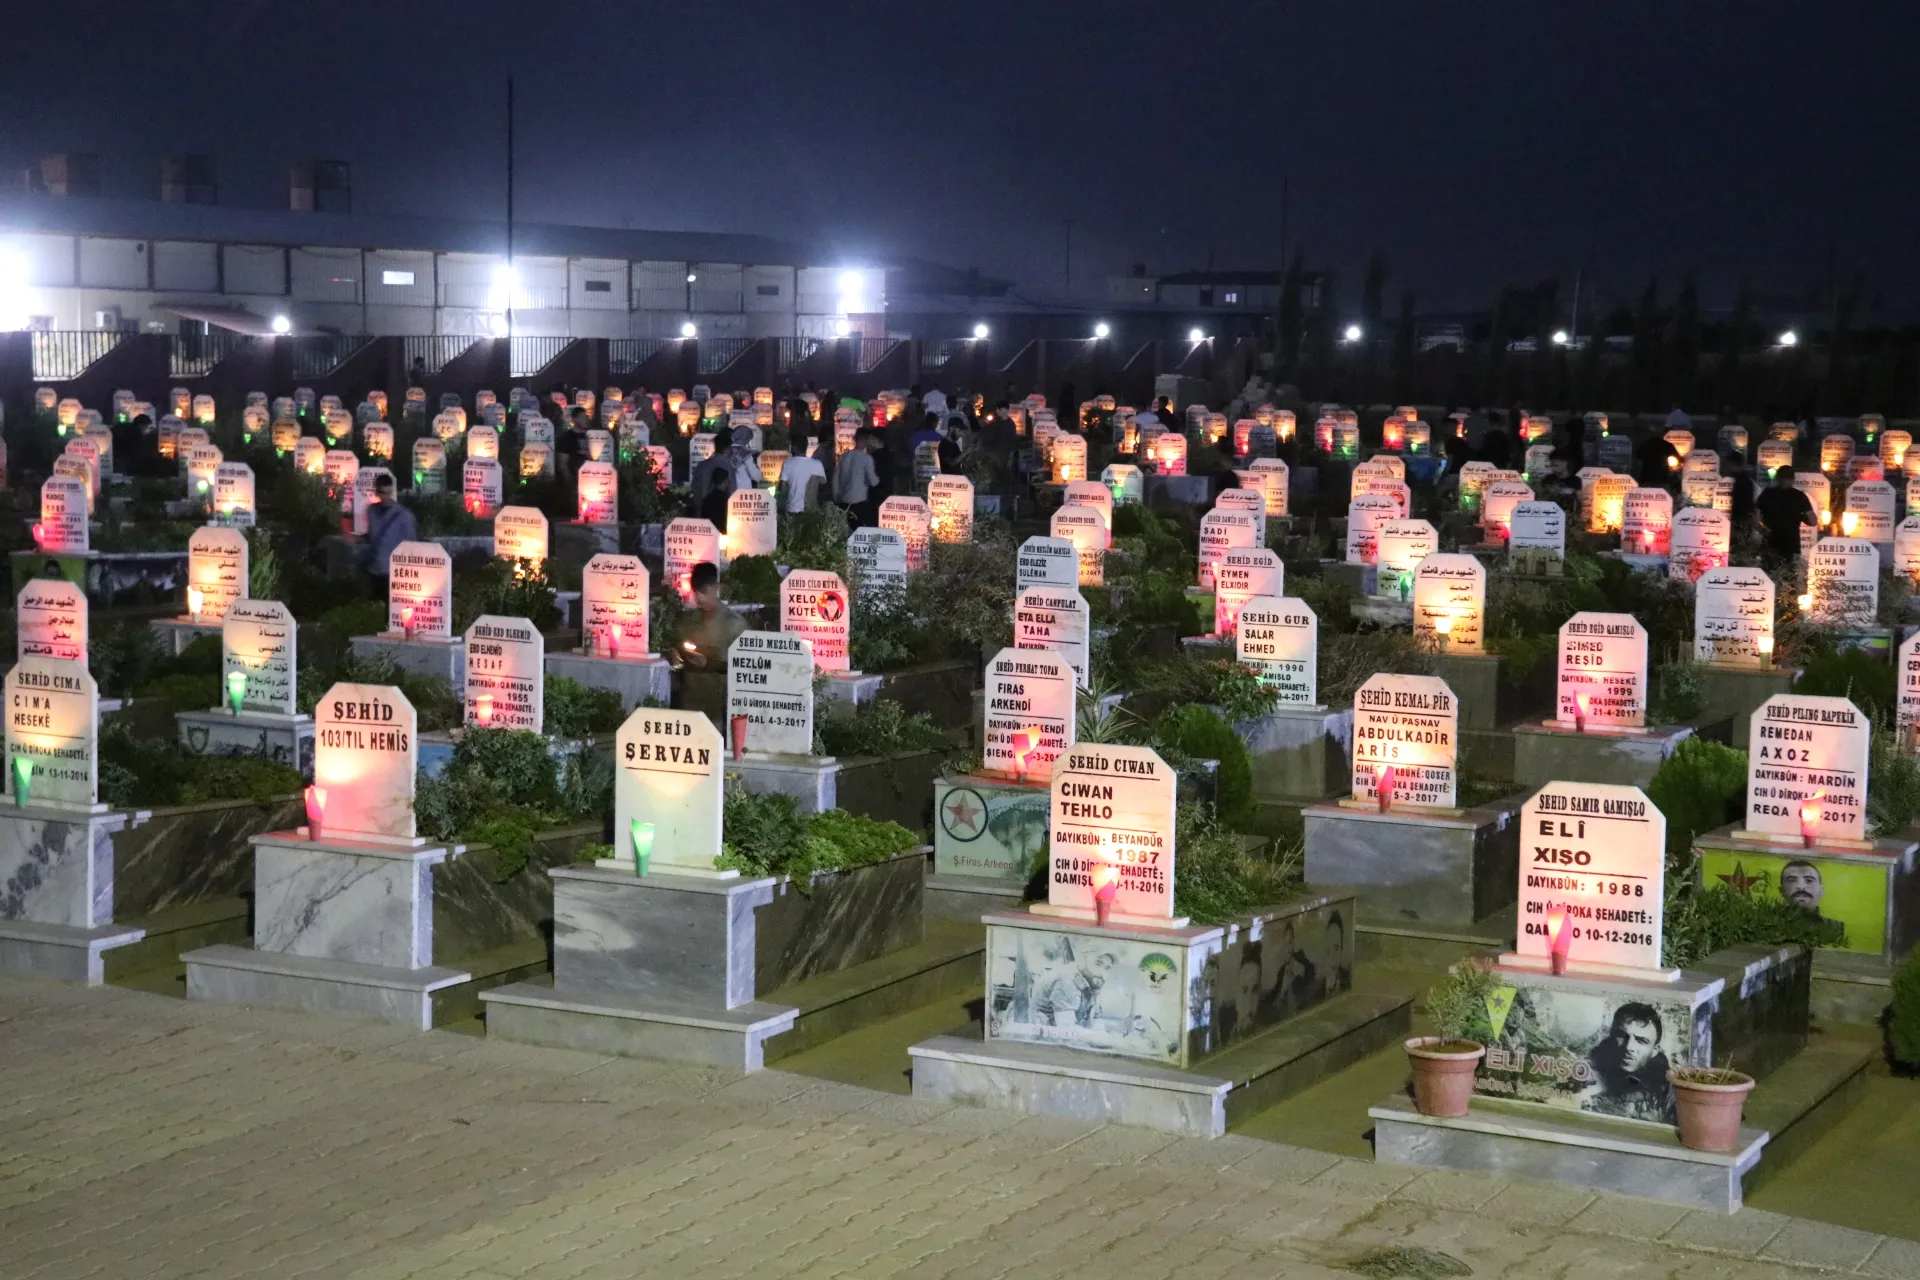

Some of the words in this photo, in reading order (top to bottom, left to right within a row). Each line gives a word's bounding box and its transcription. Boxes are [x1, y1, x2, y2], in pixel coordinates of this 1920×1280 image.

[1220, 569, 1249, 579] EYMEN
[789, 594, 817, 604] XELO
[1284, 614, 1310, 626] GUR
[1023, 625, 1050, 638] TAHA
[1244, 629, 1274, 641] SALAR
[766, 637, 802, 652] MEZLÛM
[1243, 643, 1275, 655] EHMED
[733, 656, 773, 671] MEZLÛM
[1278, 663, 1304, 673] 1990
[736, 671, 768, 685] EYLEM
[997, 682, 1025, 695] FIRAS
[1607, 687, 1633, 697] 1999
[507, 692, 529, 703] 1955
[731, 697, 742, 708] CIH
[1360, 686, 1391, 709] ŞEHÎD
[1394, 691, 1430, 711] KEMAL
[1432, 690, 1451, 711] PÎR
[14, 712, 52, 730] HESEKÊ
[768, 715, 807, 729] 4-3-2017
[1369, 713, 1390, 725] NAV
[1401, 716, 1441, 729] PAŞNAV
[320, 728, 365, 750] 103/TIL
[1357, 726, 1449, 746] ABDULKADÎR
[1760, 726, 1813, 743] REMEDAN
[624, 742, 711, 767] ŞERVAN
[1069, 753, 1108, 771] ŞEHÎD
[1113, 757, 1155, 775] CIWAN
[1356, 776, 1370, 787] CIH
[1060, 781, 1113, 801] CIWAN
[1754, 787, 1769, 799] CIH
[1060, 800, 1113, 821] TEHLO
[1570, 796, 1600, 814] SAMIR
[1602, 799, 1646, 819] QAMIŞLO
[1753, 803, 1790, 818] REQA
[1539, 820, 1586, 840] ELÎ
[1111, 830, 1164, 849] BEYANDÛR
[1115, 848, 1160, 865] 1987
[1533, 846, 1592, 868] XIŞO
[1055, 857, 1071, 872] CIH
[1595, 880, 1644, 898] 1988
[1526, 900, 1544, 914] CIH
[1585, 928, 1653, 947] 10-12-2016
[1486, 1045, 1528, 1073] ELÎ
[1530, 1052, 1593, 1083] XIŞO
